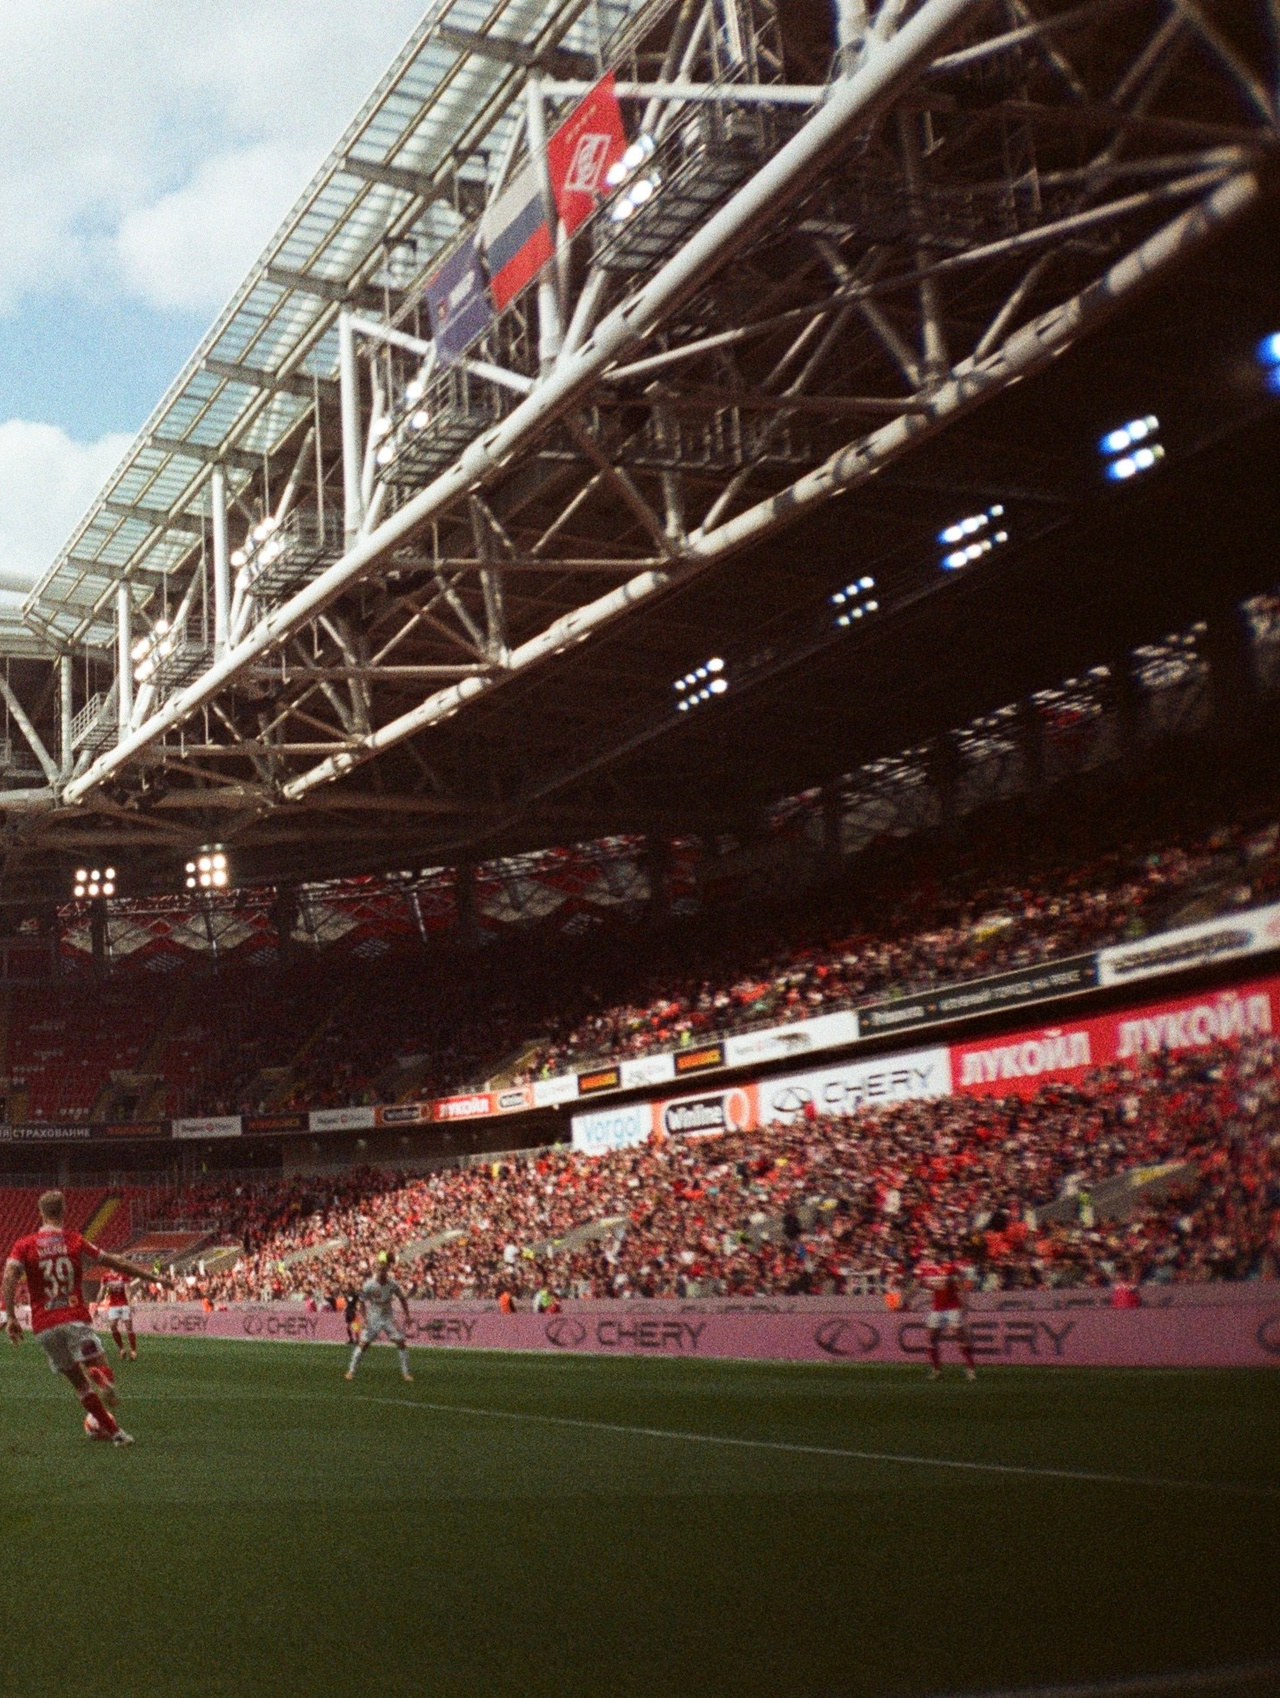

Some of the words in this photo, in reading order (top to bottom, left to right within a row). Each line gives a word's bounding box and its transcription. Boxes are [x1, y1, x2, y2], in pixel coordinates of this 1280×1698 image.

[1115, 990, 1272, 1058] ЛУКОЙЛ
[960, 1029, 1091, 1085] ЛУКОЙЛ
[823, 1063, 935, 1103] CHERY
[38, 1256, 75, 1298] 39
[170, 1315, 208, 1331] CHERY
[267, 1316, 318, 1336] CHERY
[596, 1320, 707, 1348] CHERY
